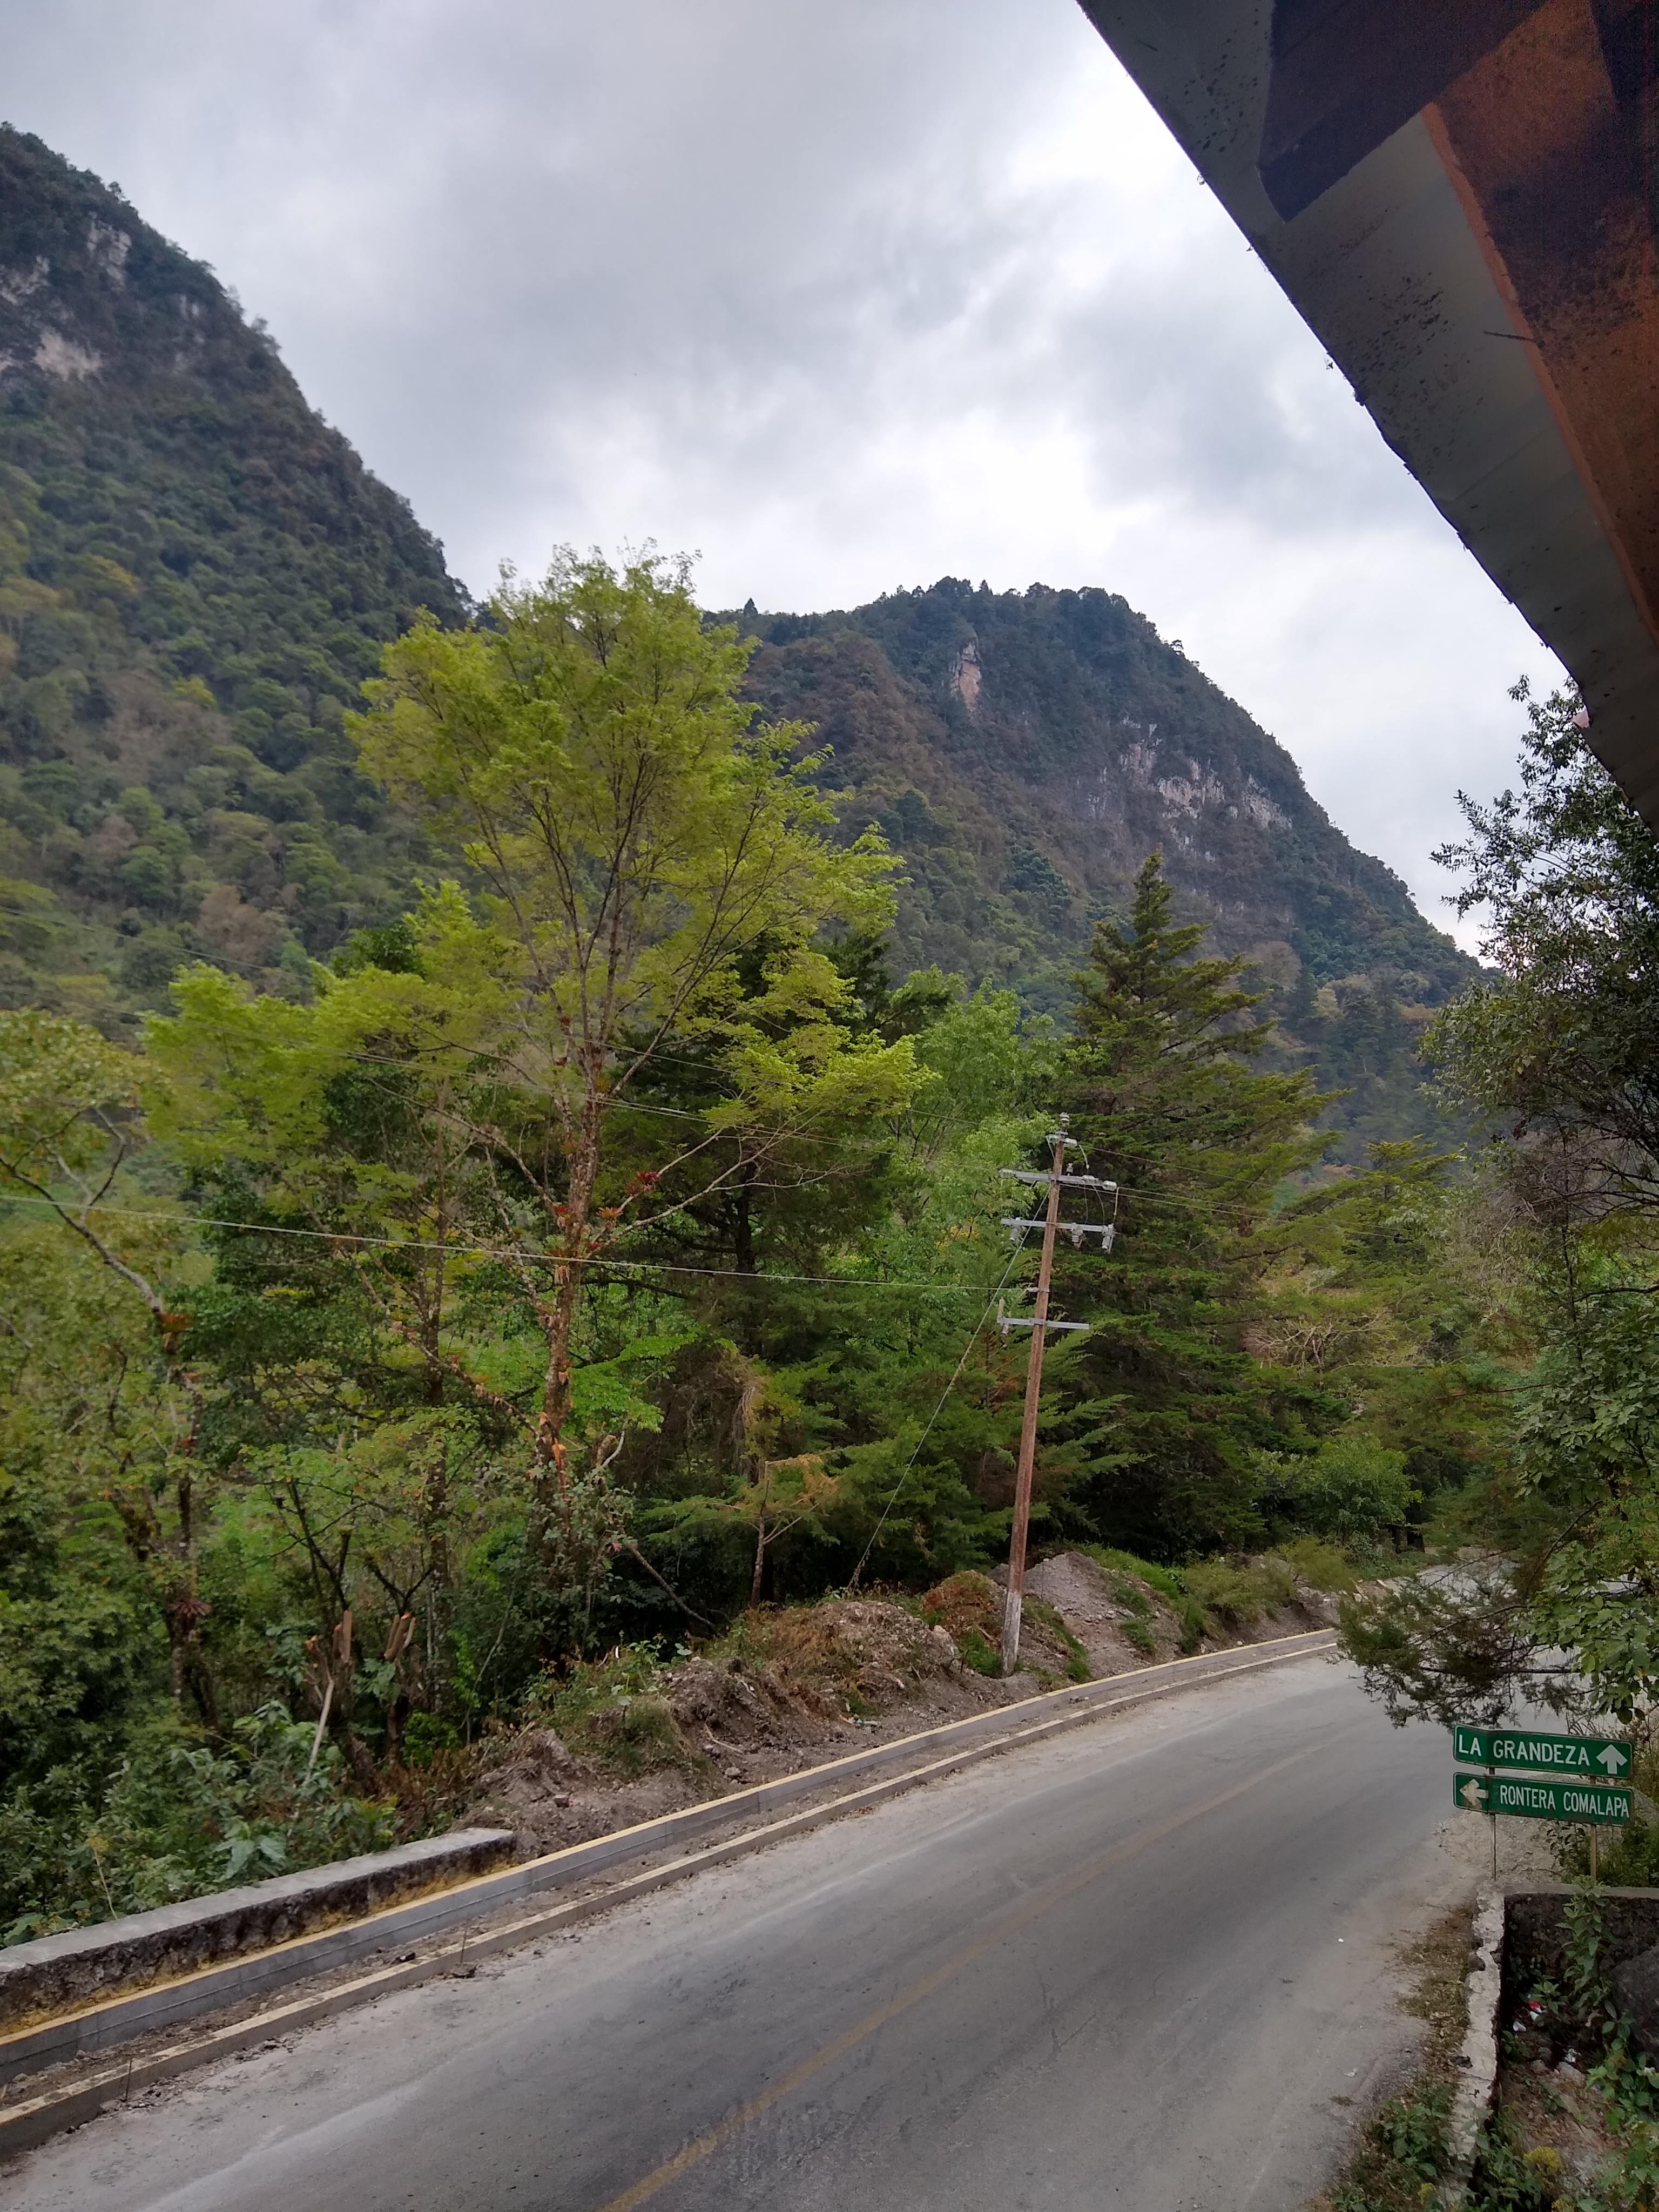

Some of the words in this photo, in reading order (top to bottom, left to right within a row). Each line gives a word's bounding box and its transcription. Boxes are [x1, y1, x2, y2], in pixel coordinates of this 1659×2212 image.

[1459, 1734, 1481, 1756] LA
[1493, 1740, 1590, 1766] GRANDEZA
[1563, 1791, 1629, 1818] COMALAPA
